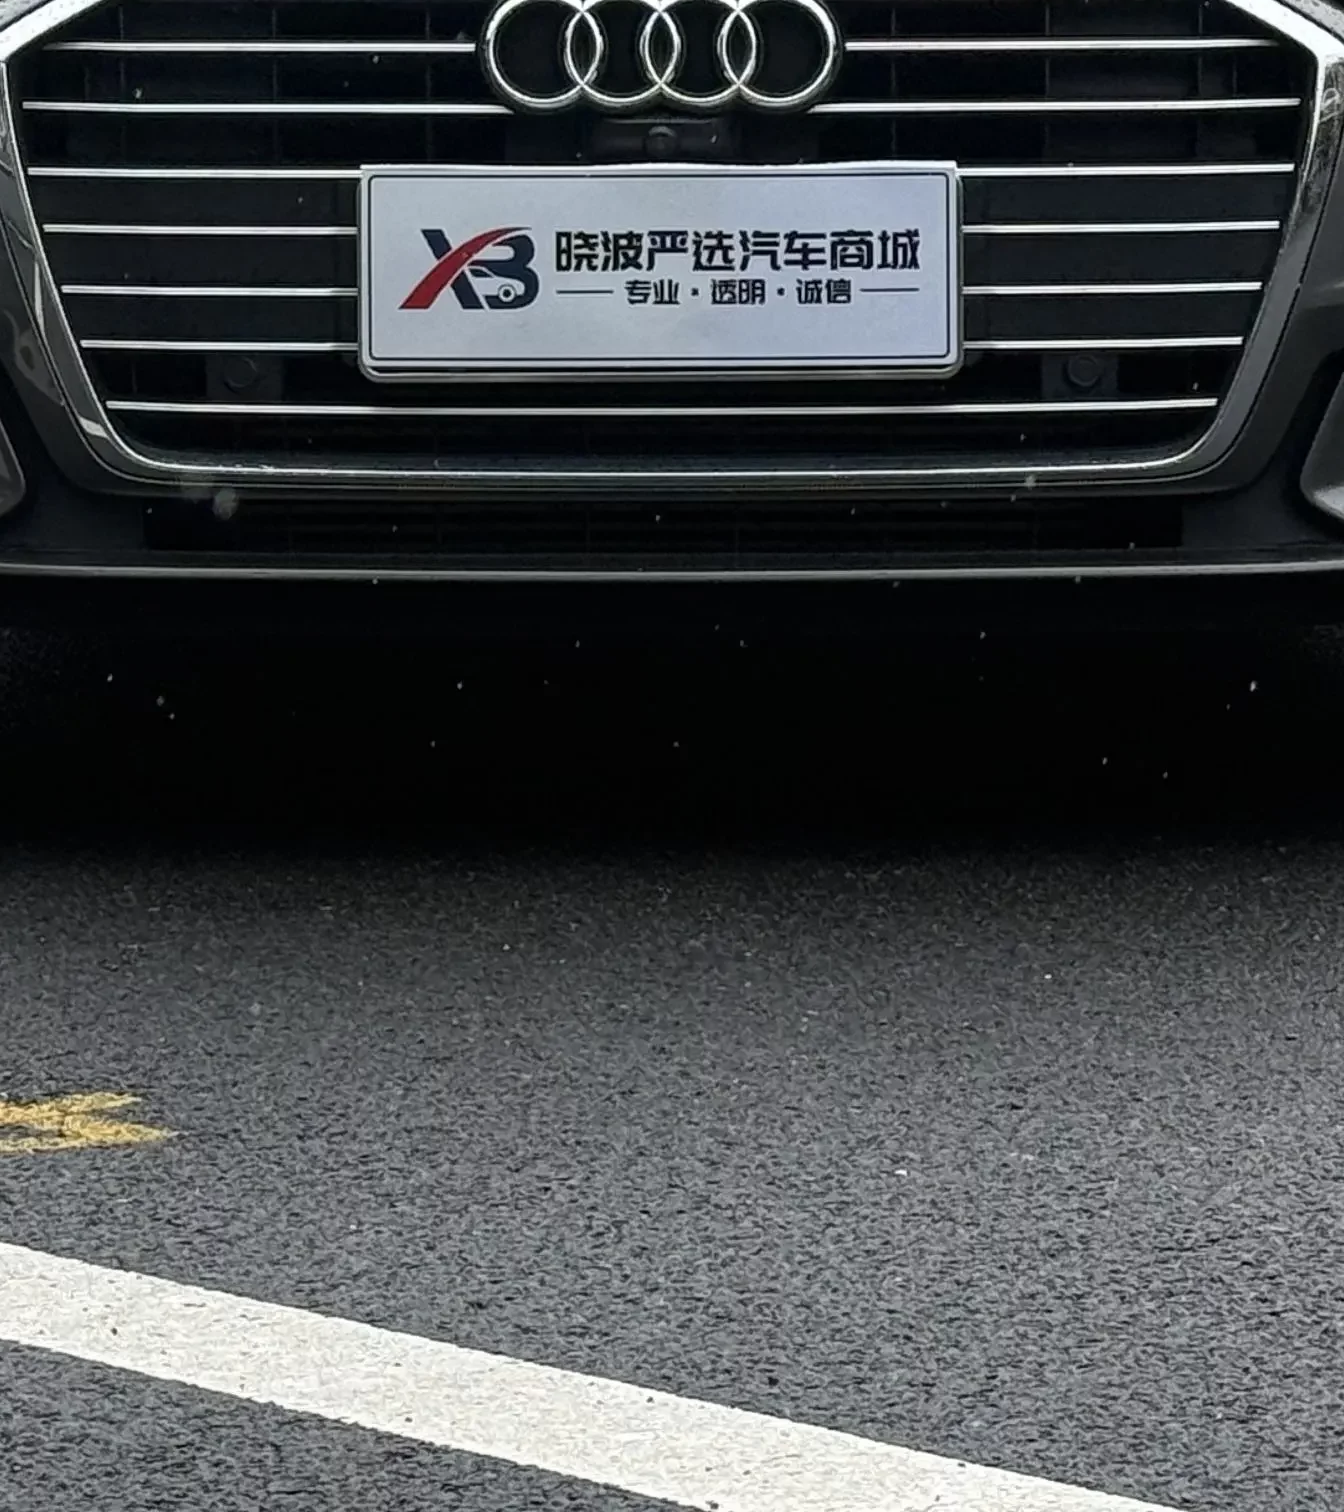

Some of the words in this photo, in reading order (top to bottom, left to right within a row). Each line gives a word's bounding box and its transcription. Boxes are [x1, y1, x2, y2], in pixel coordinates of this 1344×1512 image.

[555, 228, 921, 273] 晓波严选汽车商城
